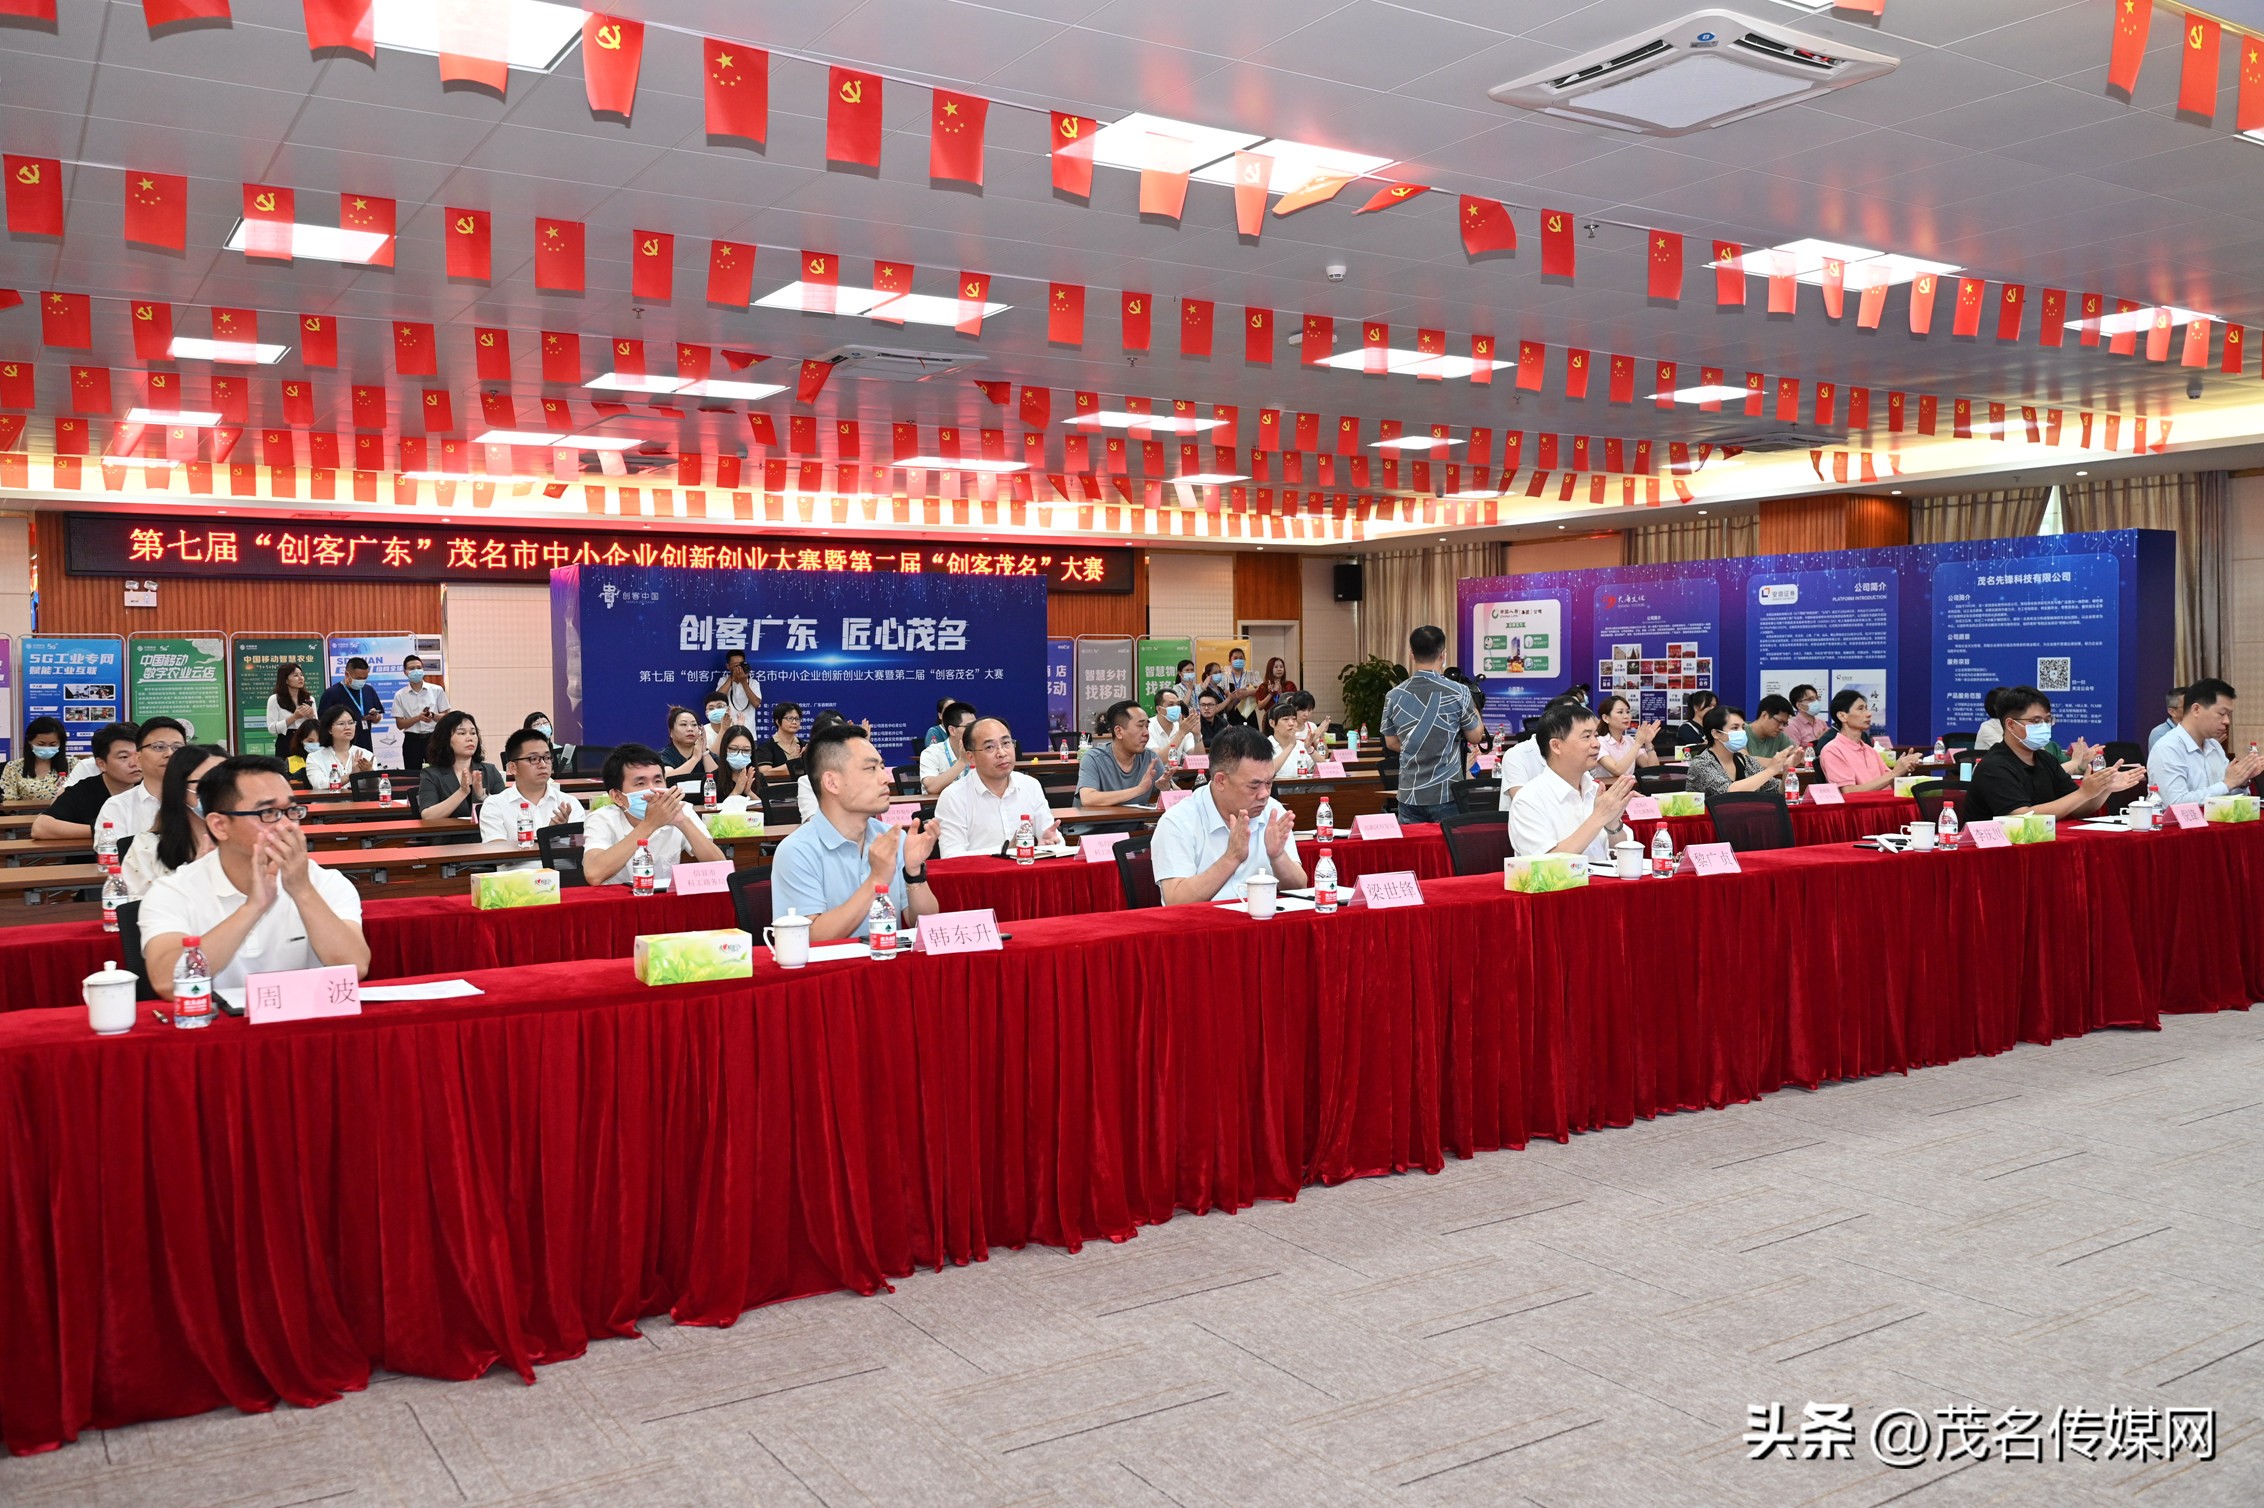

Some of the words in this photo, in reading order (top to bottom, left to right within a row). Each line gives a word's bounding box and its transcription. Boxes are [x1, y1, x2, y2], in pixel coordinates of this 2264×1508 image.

[1977, 572, 2071, 586] 茂名先锋科技有限公司
[1854, 582, 1887, 592] 公司简介
[679, 614, 818, 651] 创客广东
[842, 615, 970, 651] 匠心茂名
[29, 653, 114, 664] 5G工业专网
[140, 654, 188, 666] 中国移动
[243, 655, 314, 664] 中国移动智慧农业
[337, 657, 383, 666] SDAN
[29, 666, 97, 675] 赋能工业互联
[143, 666, 216, 679] 数字农业云店
[639, 667, 1004, 684] 第七届“创客广东茂名市中小企业创新创业大赛暨第二届“创客茂名”大赛
[1085, 669, 1126, 681] 智慧乡村
[1145, 665, 1178, 677] 智慧物
[1085, 684, 1126, 700] 找移动
[1145, 681, 1178, 695] 找移
[1973, 827, 2006, 842] 李庆川
[1367, 881, 1416, 901] 梁世锋
[928, 923, 991, 948] 韩东升
